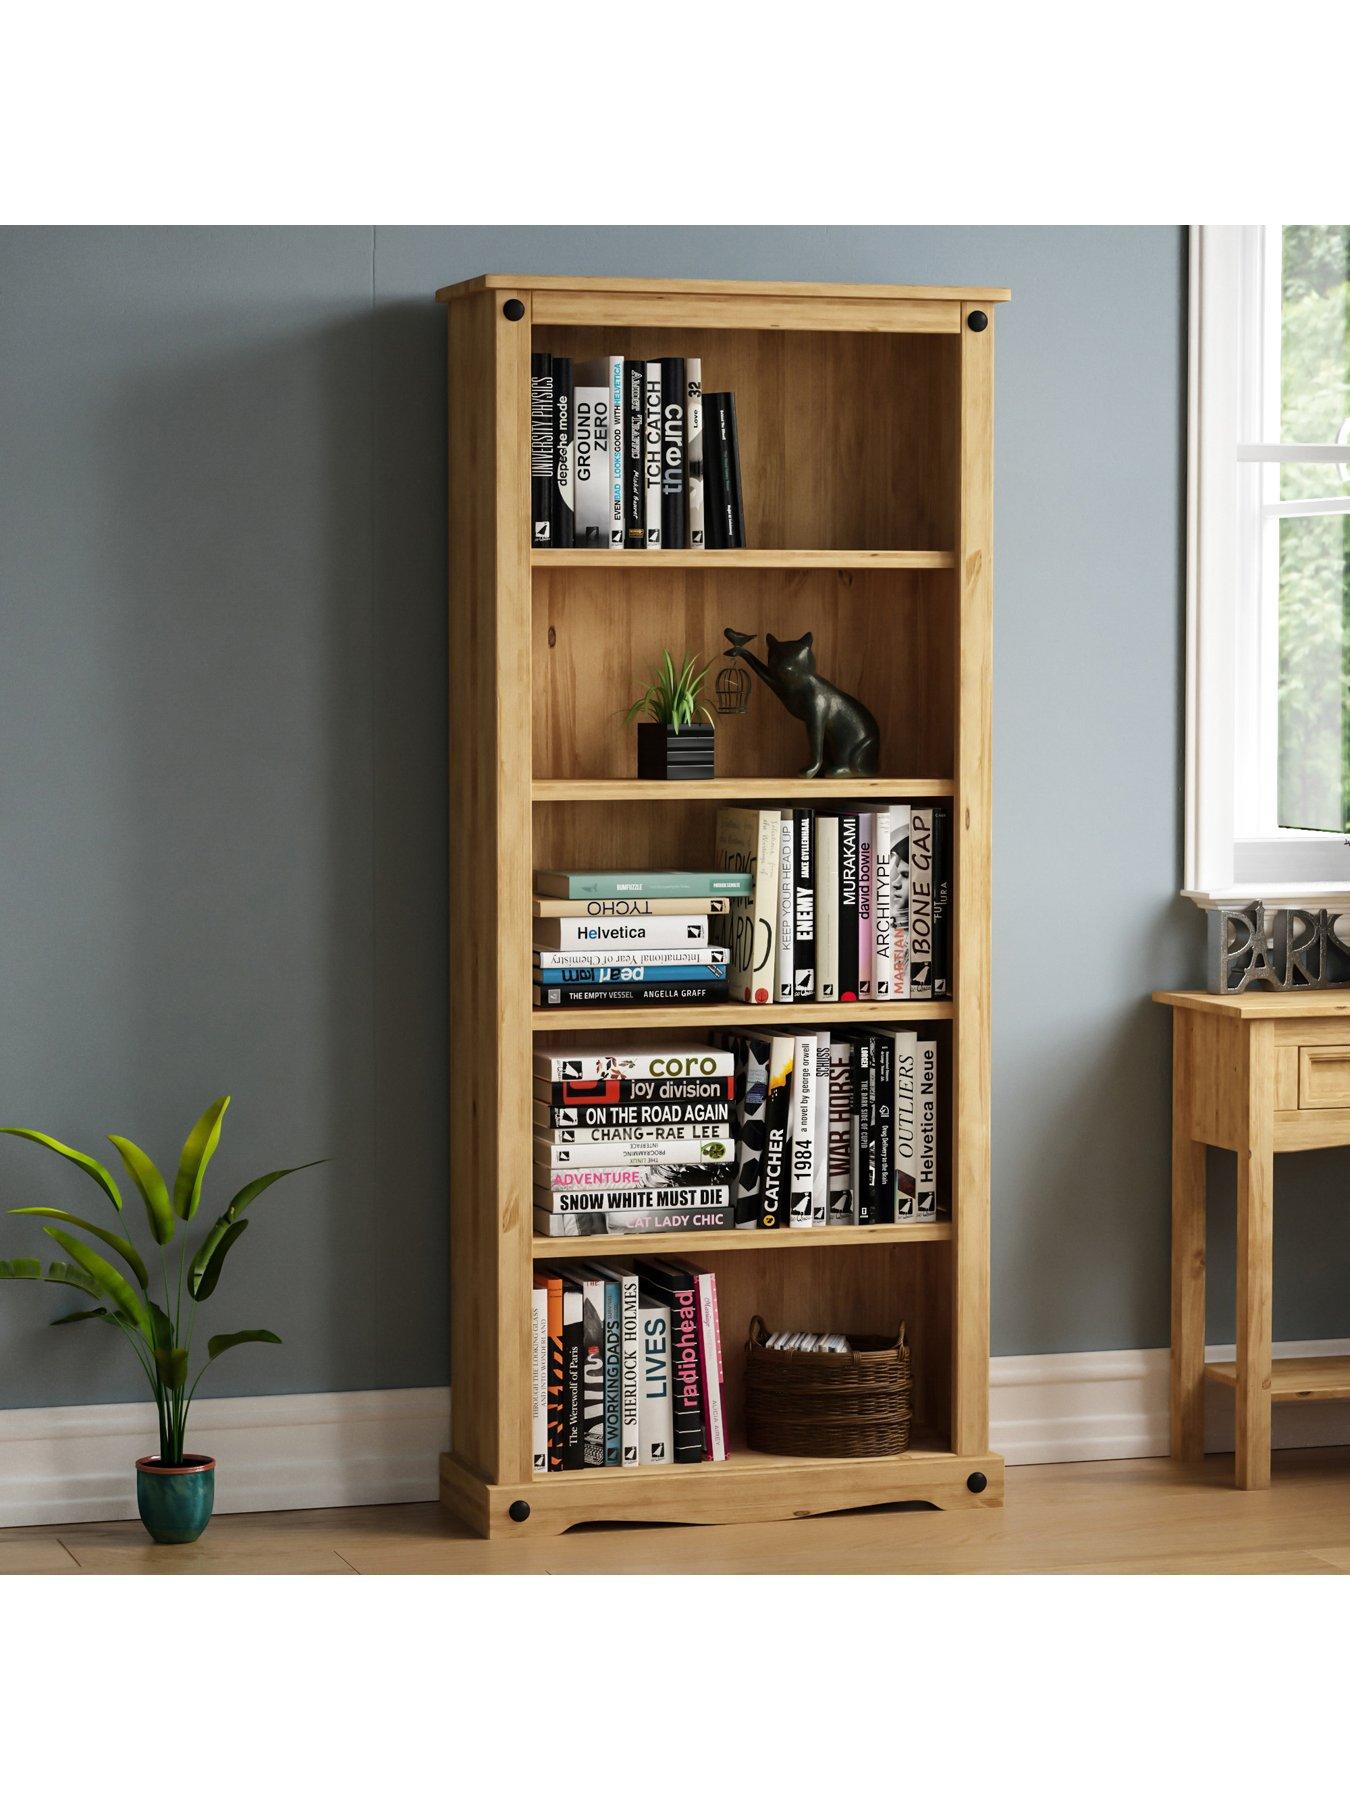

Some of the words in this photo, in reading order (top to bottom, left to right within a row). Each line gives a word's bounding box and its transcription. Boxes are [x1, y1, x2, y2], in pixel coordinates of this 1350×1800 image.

[532, 376, 553, 418] PHYSICS
[688, 381, 701, 398] 32
[557, 395, 568, 430] mode
[594, 402, 608, 452] ZERO
[647, 381, 661, 444] CATCH
[532, 420, 553, 476] UNIVERSITY
[578, 402, 590, 481] GROUND
[557, 434, 570, 486] depeche
[647, 450, 661, 488] TCH
[782, 826, 792, 842] UP
[801, 818, 810, 860] GYLLENHAAL
[912, 816, 931, 870] GAP
[782, 846, 792, 879] HEAD
[801, 861, 810, 878] JAKE
[843, 818, 856, 904] MURAKAMI
[859, 842, 870, 882] bowie
[588, 901, 652, 916] TYCHO
[782, 882, 792, 916] YOUR
[796, 887, 813, 940] ENEMY
[859, 886, 870, 920] david
[876, 854, 890, 958] ARCHITYPE
[578, 926, 646, 940] Helvetica
[782, 920, 791, 950] KEEP
[912, 882, 931, 955] BONE
[551, 954, 600, 966] Chemistry
[562, 968, 595, 982] jam
[599, 966, 644, 982] pearl
[602, 956, 613, 966] of
[616, 954, 638, 964] Year
[640, 954, 700, 964] International
[894, 928, 904, 994] MARTIAN
[644, 990, 678, 998] ANGELLA
[682, 989, 706, 997] GRAFF
[649, 1058, 716, 1076] coro
[816, 1048, 830, 1078] SCHUSS
[921, 1050, 934, 1095] Neue
[630, 1080, 654, 1099] joy
[660, 1080, 720, 1098] division
[802, 1069, 810, 1093] george
[829, 1057, 850, 1123] HORSE
[586, 1108, 606, 1124] ON
[610, 1106, 637, 1124] THE
[642, 1106, 682, 1122] ROAD
[684, 1104, 728, 1121] AGAIN
[800, 1094, 809, 1104] by
[898, 1055, 914, 1158] OUTLIERS
[591, 1127, 684, 1140] CHANG-RAE
[692, 1126, 720, 1138] LEE
[881, 1138, 889, 1157] Delivery
[921, 1102, 934, 1183] Helvetica
[764, 1128, 784, 1212] CATCHER
[794, 1140, 812, 1180] 1984
[829, 1130, 850, 1177] WAR
[554, 1172, 640, 1186] ADVENTURE
[560, 1194, 604, 1210] SNOW
[608, 1192, 652, 1208] WHITE
[657, 1190, 696, 1206] MUST
[700, 1189, 722, 1204] DIE
[654, 1216, 690, 1228] LADY
[693, 1214, 724, 1226] CHIC
[624, 1284, 637, 1341] HOLMES
[569, 1346, 578, 1368] Paris
[644, 1318, 666, 1398] LIVES
[675, 1291, 698, 1407] radiohead
[569, 1370, 578, 1380] of
[624, 1350, 637, 1426] SHERLOCK
[569, 1382, 578, 1425] Werewolf
[569, 1427, 578, 1446] The
